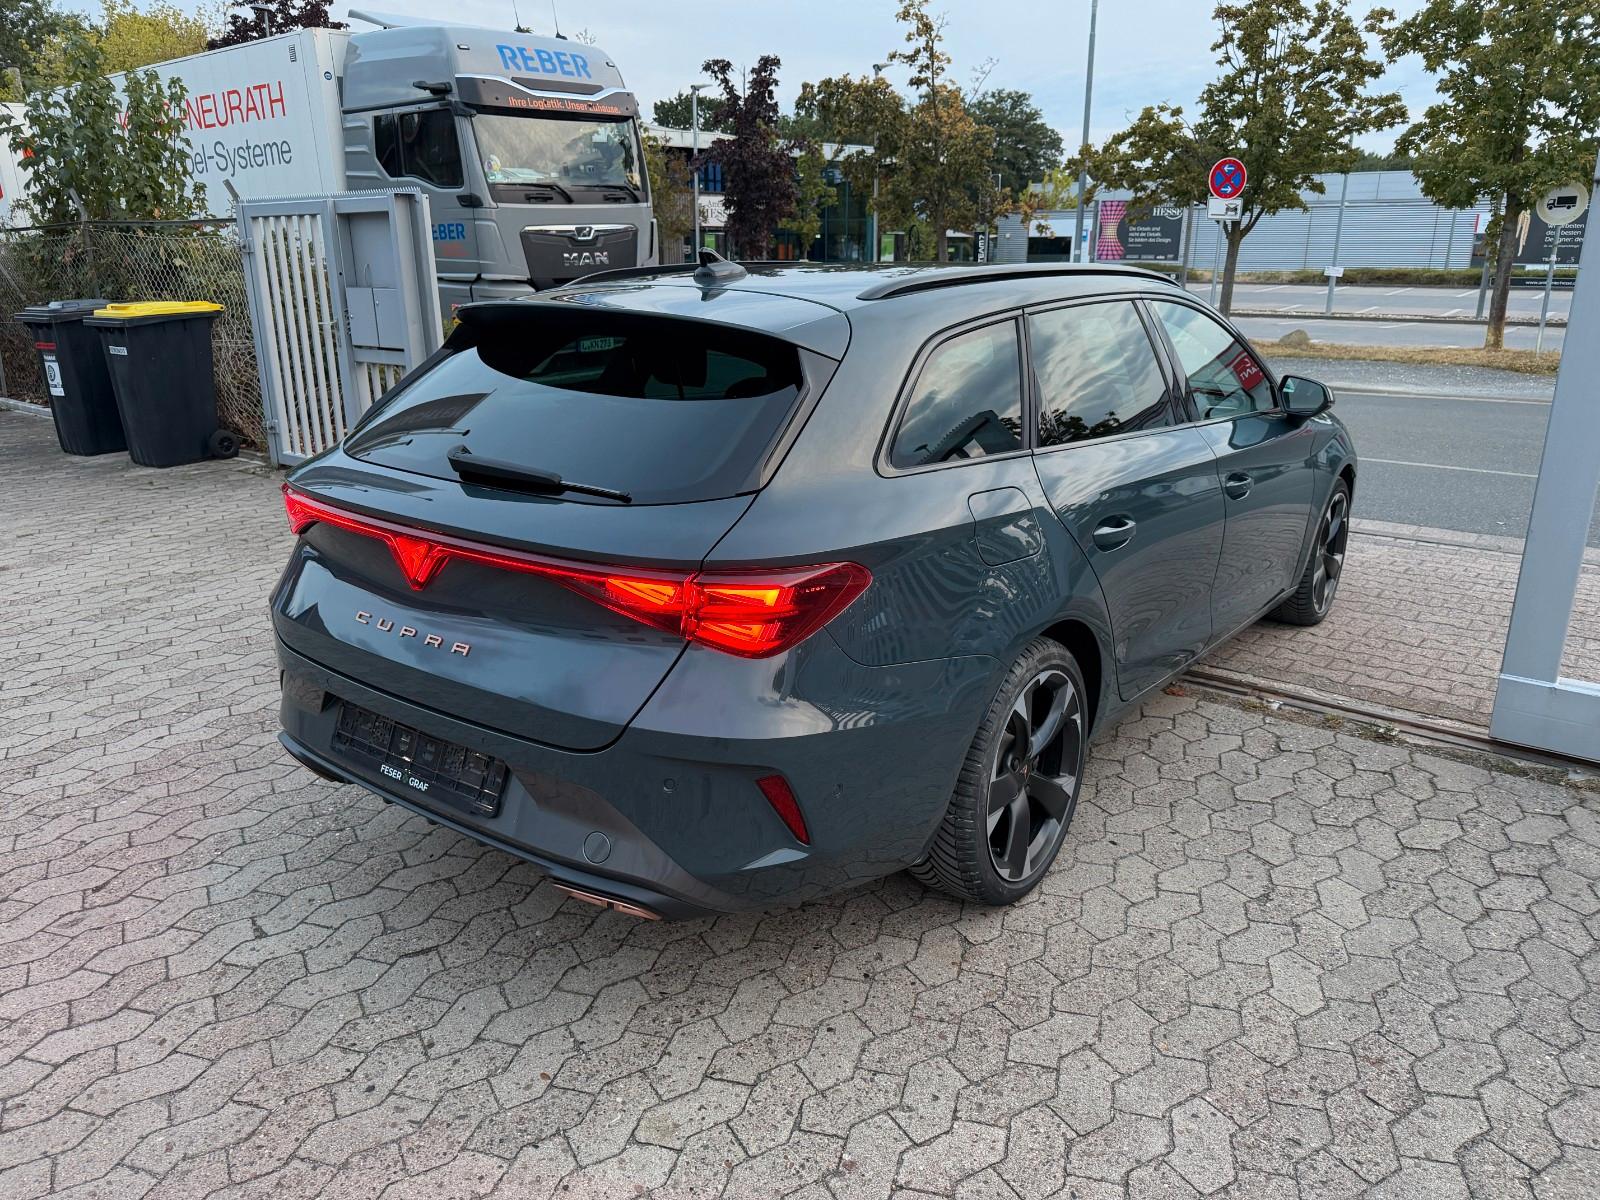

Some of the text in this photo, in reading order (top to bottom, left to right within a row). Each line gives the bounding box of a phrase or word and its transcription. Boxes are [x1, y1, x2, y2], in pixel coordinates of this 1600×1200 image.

[496, 44, 592, 79] REBER
[508, 96, 527, 107] Ihre
[528, 98, 565, 110] Logistik.
[565, 100, 588, 111] Unser
[1152, 207, 1183, 218] HESSE
[431, 223, 466, 240] EBER
[563, 251, 609, 266] MAN
[355, 610, 471, 657] CUPRA
[380, 764, 430, 792] FESER GRAF
